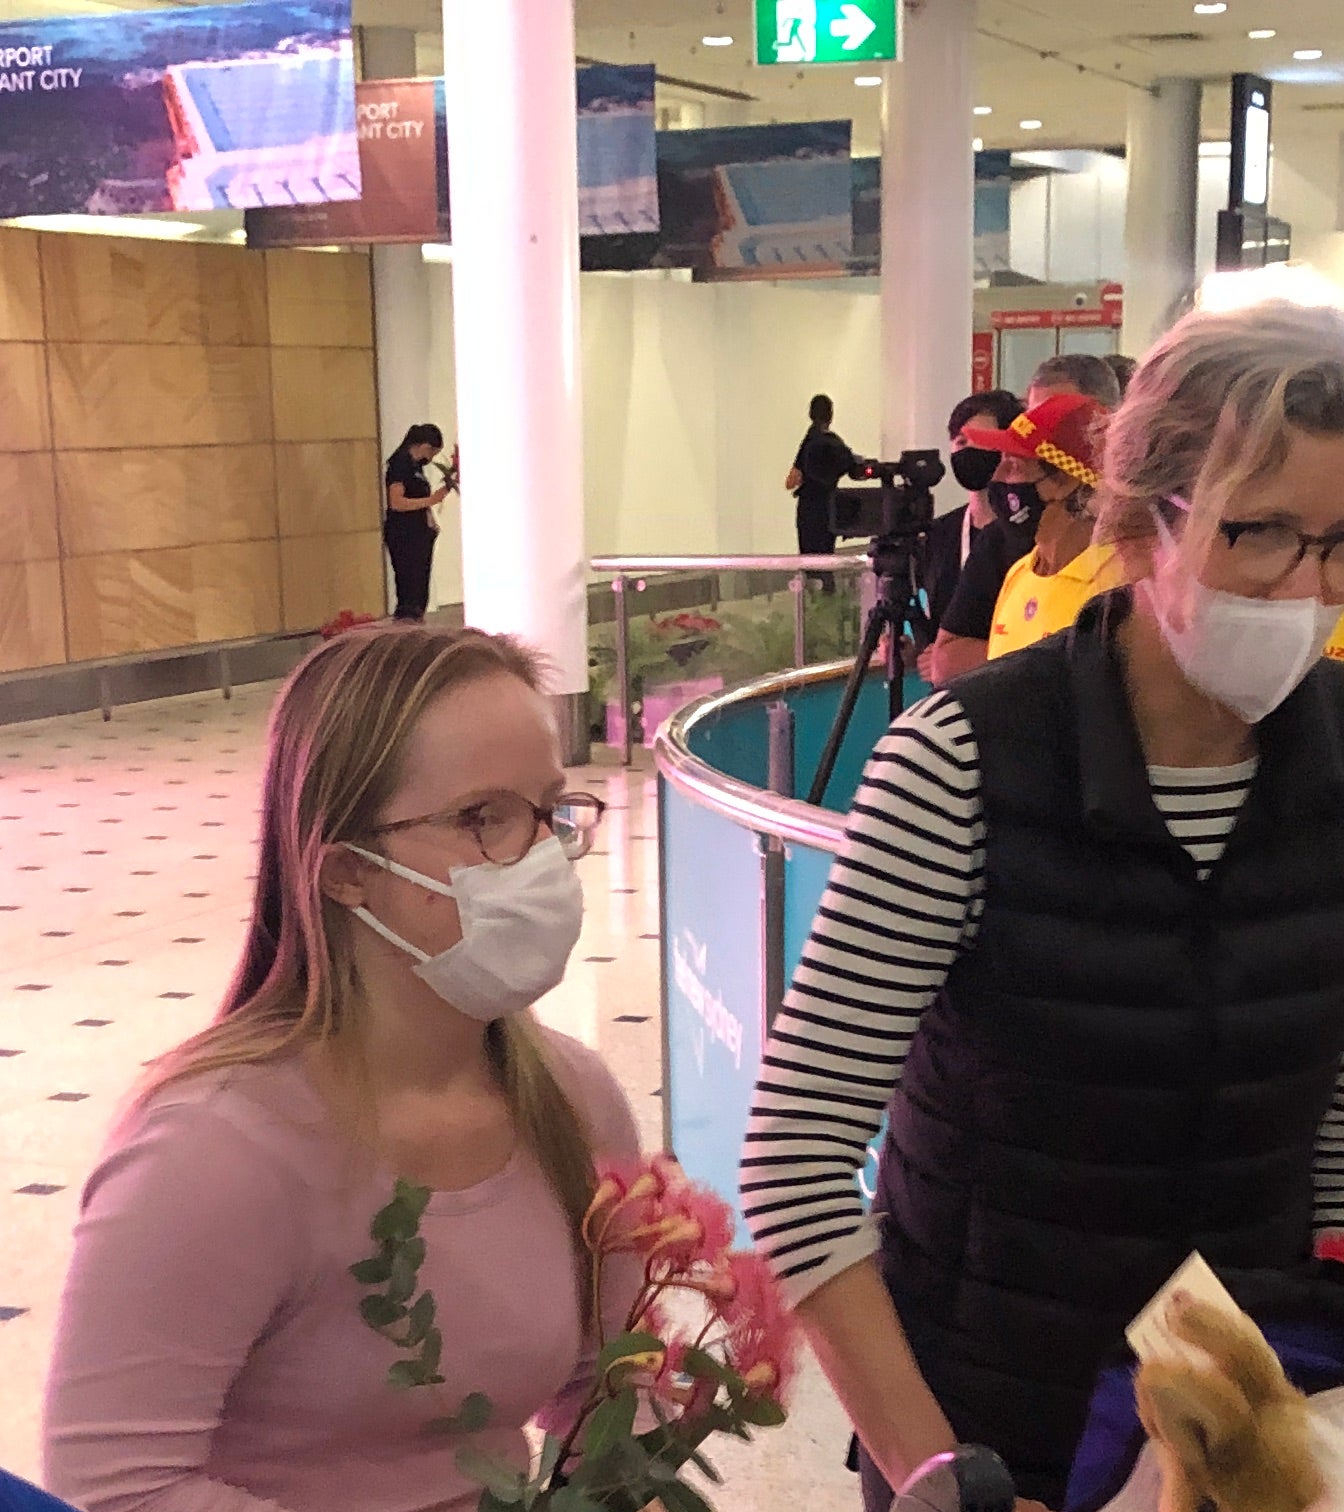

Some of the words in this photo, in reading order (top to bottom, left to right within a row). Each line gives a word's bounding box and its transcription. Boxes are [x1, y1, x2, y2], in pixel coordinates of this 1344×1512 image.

[40, 67, 83, 91] CITY
[357, 102, 399, 121] PORT
[385, 120, 425, 139] CITY
